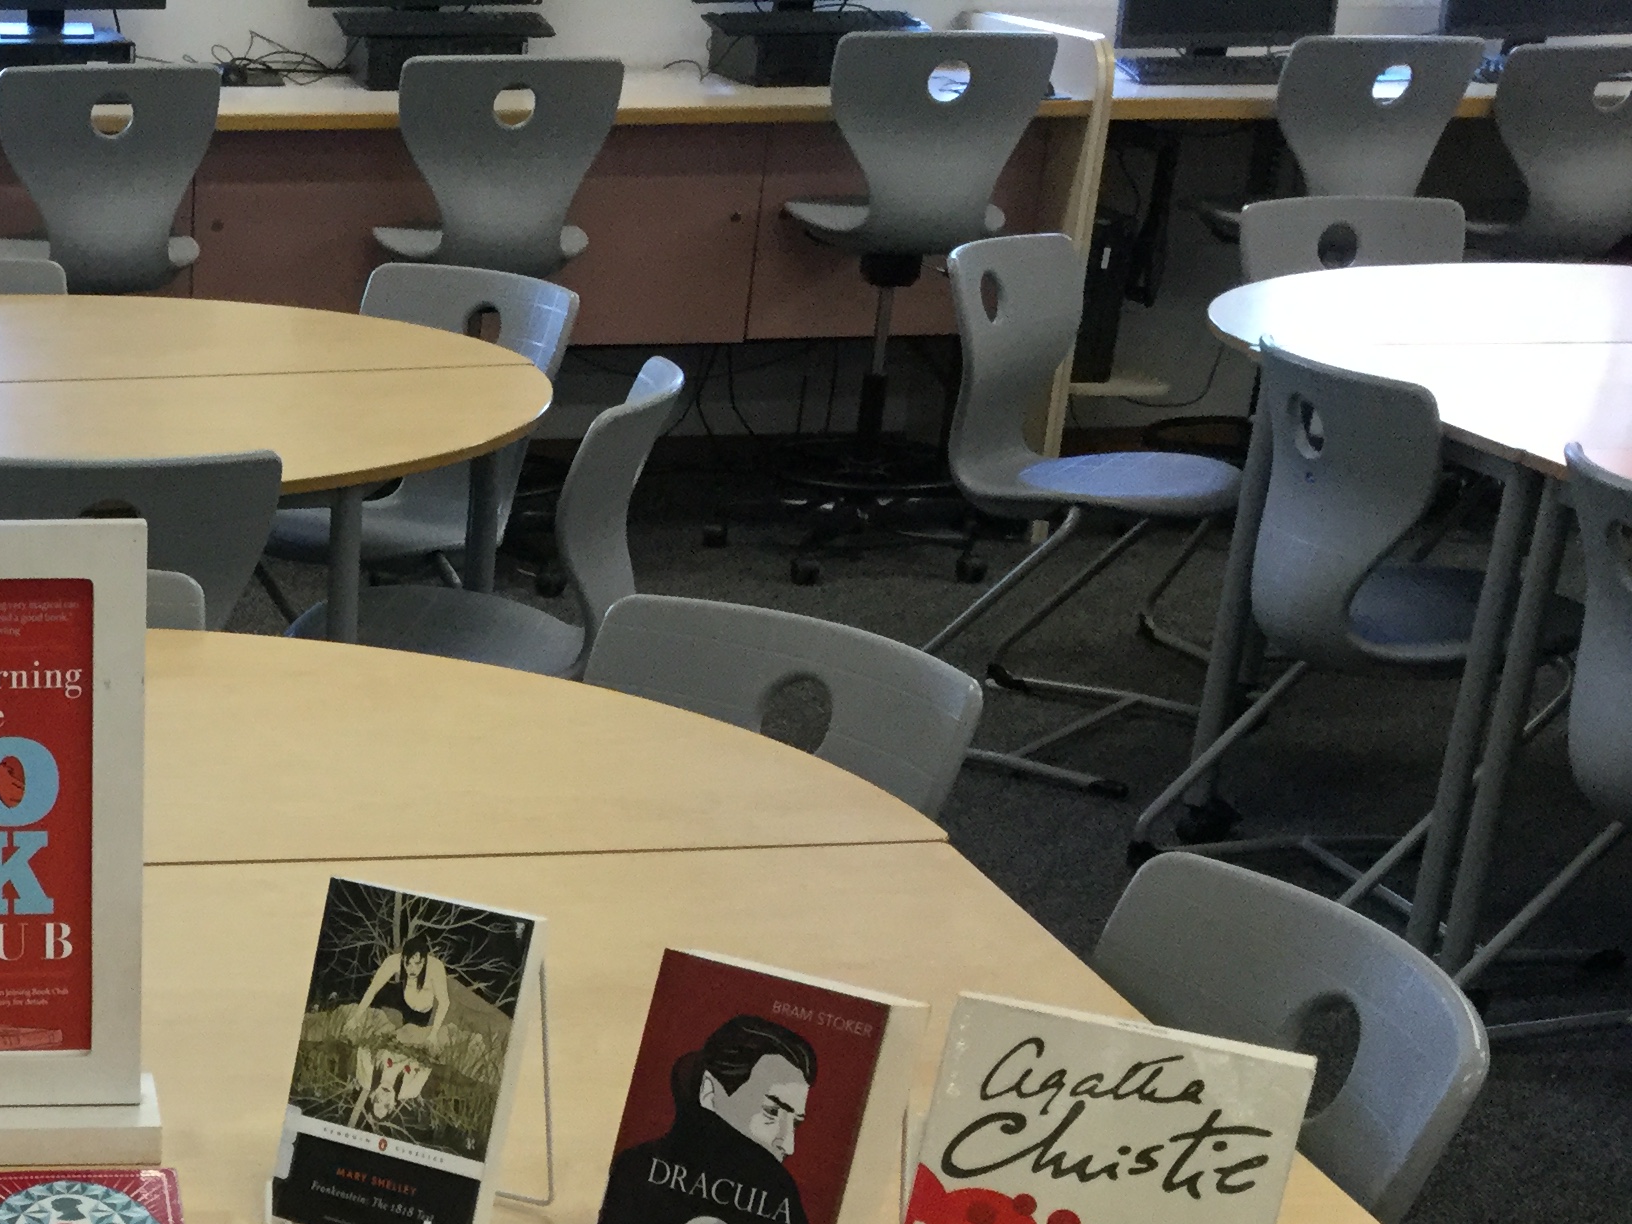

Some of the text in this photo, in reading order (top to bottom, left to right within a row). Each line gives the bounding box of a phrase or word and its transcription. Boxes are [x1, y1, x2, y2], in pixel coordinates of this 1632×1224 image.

[772, 1000, 873, 1039] BRAM STOKER
[940, 1101, 1274, 1200] Christie
[336, 1167, 417, 1196] MARY SHELLEY
[372, 1196, 387, 1211] The
